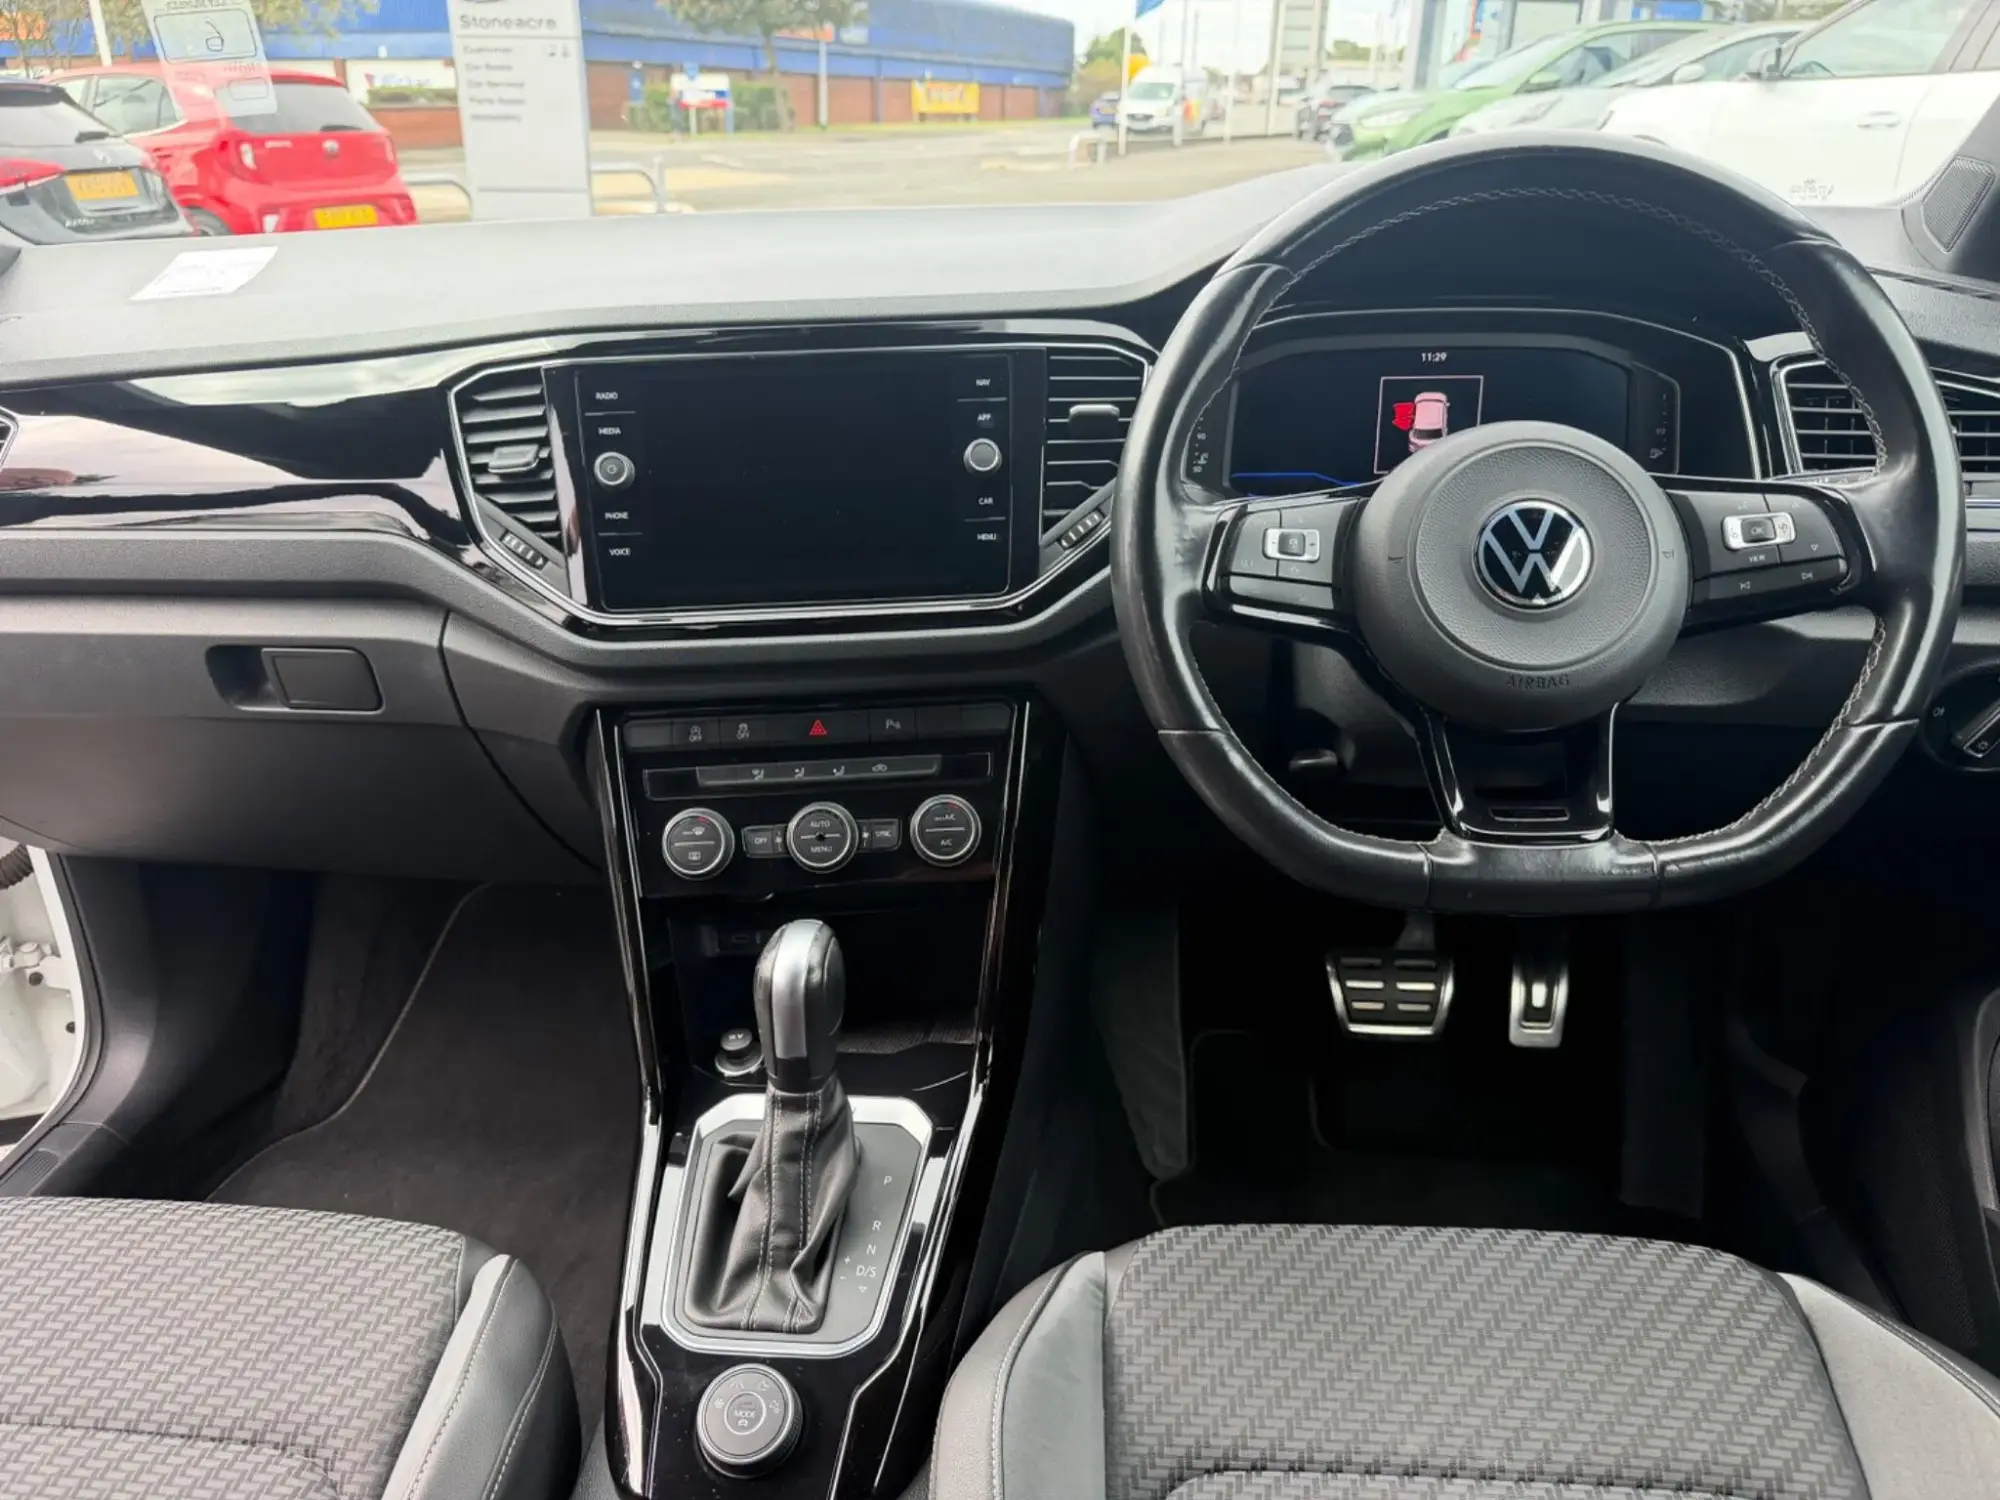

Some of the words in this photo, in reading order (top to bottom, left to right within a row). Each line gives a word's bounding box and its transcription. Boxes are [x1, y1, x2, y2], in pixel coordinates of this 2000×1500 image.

[460, 14, 557, 30] Stoneacre
[1421, 351, 1448, 362] 11:29
[595, 392, 618, 400] RADIO
[598, 427, 621, 435] MEDIA
[978, 497, 994, 505] CAR
[605, 511, 629, 520] PHONE
[977, 533, 997, 541] MENU
[609, 548, 631, 556] VOICE
[1506, 674, 1570, 690] AIRBAG
[810, 820, 831, 829] AUTO
[754, 835, 769, 845] OFF
[810, 845, 833, 854] MENU
[884, 1175, 893, 1186] P
[872, 1220, 882, 1232] R
[866, 1244, 877, 1255] N
[855, 1264, 877, 1278] D/S
[734, 1410, 757, 1418] MODE
